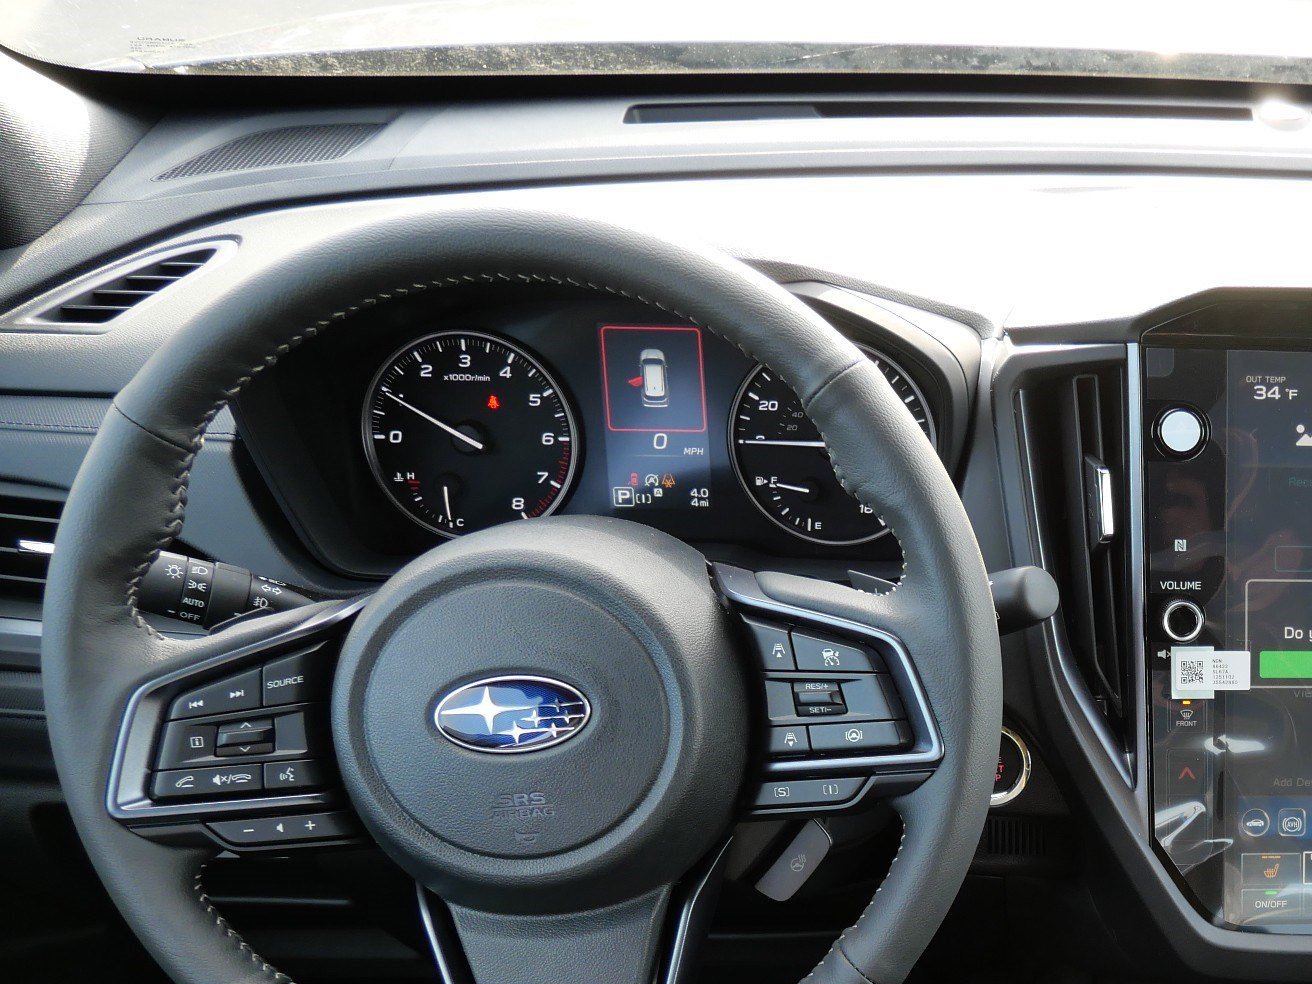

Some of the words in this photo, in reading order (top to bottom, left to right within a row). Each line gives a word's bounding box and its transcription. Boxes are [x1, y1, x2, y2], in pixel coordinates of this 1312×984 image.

[459, 355, 471, 368] 3
[420, 365, 433, 377] 2
[500, 366, 512, 378] 4
[443, 374, 491, 382] x1000r/min
[1246, 375, 1262, 383] OUT
[1253, 385, 1281, 400] 34
[529, 394, 541, 406] 5
[758, 401, 778, 411] 20
[389, 431, 402, 444] 0
[542, 433, 554, 445] 6
[653, 433, 668, 450] 0
[683, 447, 704, 455] MPH
[537, 472, 549, 484] 7
[617, 490, 630, 503] P
[690, 488, 709, 498] 4.0
[512, 498, 525, 510] 8
[815, 522, 822, 530] E
[1160, 580, 1202, 590] VOLUME
[182, 597, 204, 608] AUTO
[180, 611, 200, 621] OFF
[1284, 626, 1303, 639] Do
[267, 675, 304, 690] SOURCE
[1273, 778, 1293, 787] Add
[500, 792, 545, 805] SRS
[1255, 900, 1288, 909] ON/OFF
